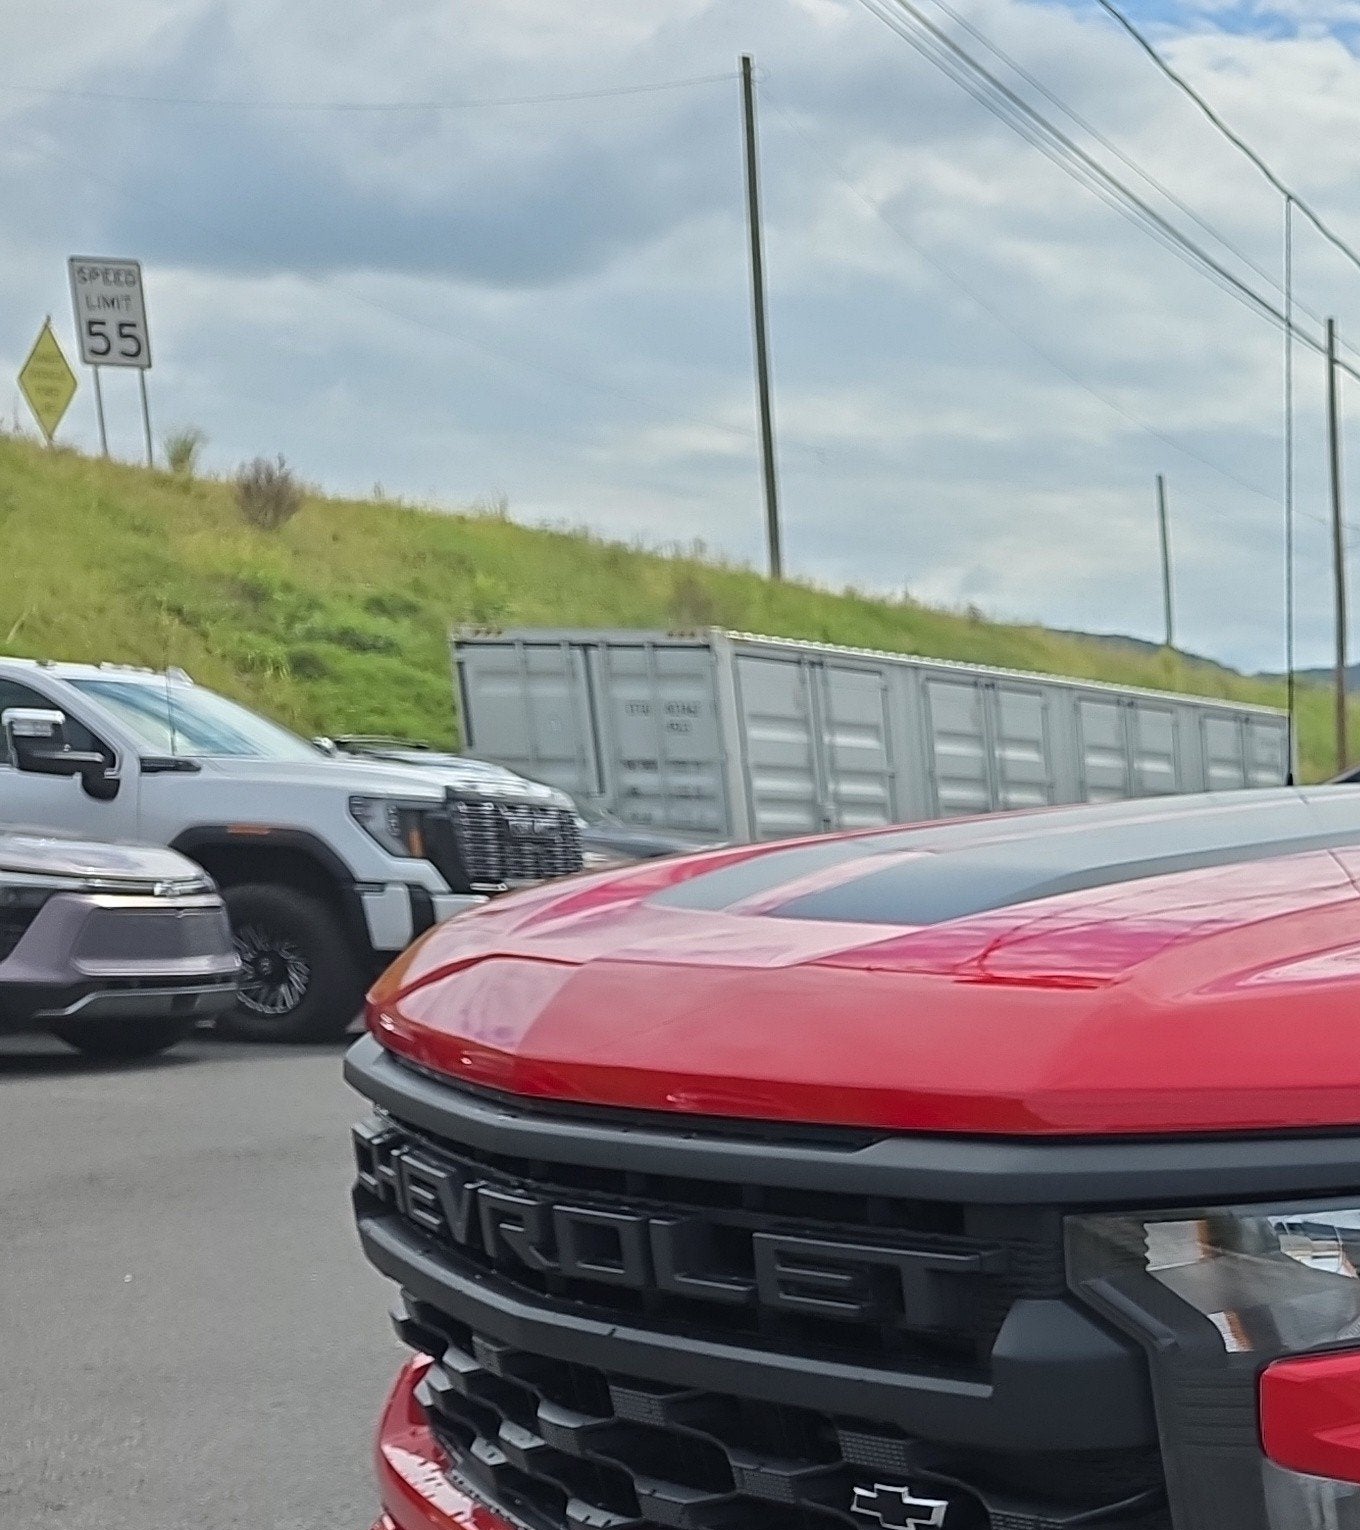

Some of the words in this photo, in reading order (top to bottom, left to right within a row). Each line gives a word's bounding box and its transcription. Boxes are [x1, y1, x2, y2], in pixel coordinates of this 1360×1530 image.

[76, 266, 136, 288] SPEED
[85, 294, 133, 312] LIMIT
[87, 320, 142, 358] 55
[351, 1120, 982, 1326] CHEVROLET
